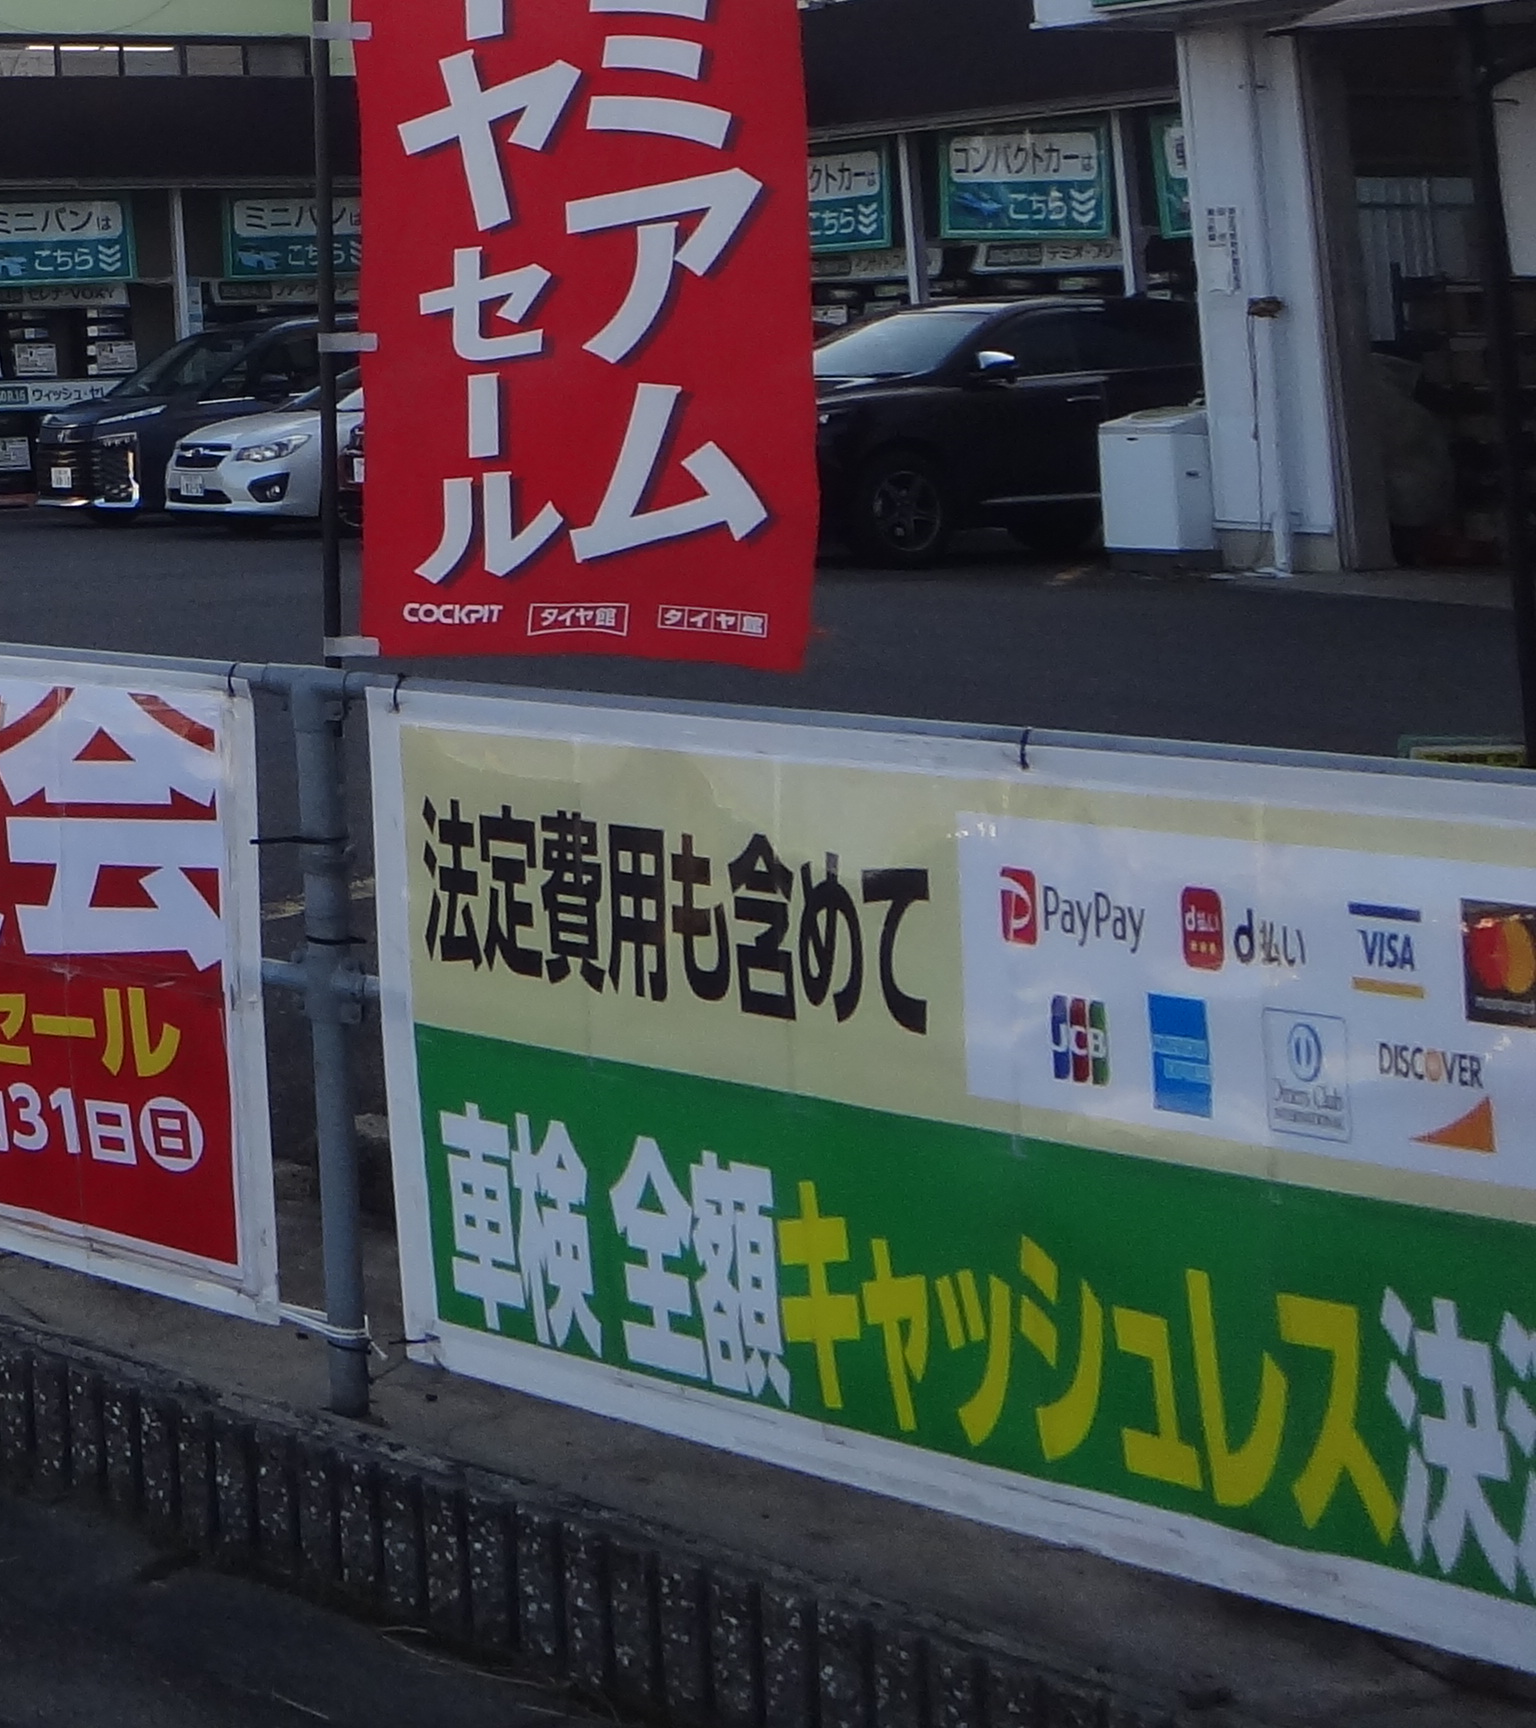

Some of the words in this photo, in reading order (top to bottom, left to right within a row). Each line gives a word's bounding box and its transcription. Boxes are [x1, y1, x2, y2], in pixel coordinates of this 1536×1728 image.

[954, 140, 1096, 174] コンパクトカーは
[1009, 192, 1067, 221] こちら
[34, 248, 95, 271] こちら
[403, 603, 503, 626] COCKPIT
[539, 605, 618, 629] タイヤ館
[663, 608, 765, 636] タイヤ館
[422, 795, 930, 1035] 法定費用も含めて
[1043, 884, 1146, 955] PayPay
[1357, 929, 1416, 971] VISA
[1050, 1027, 1108, 1059] JCB
[1378, 1040, 1484, 1090] DISCOVER
[439, 1102, 603, 1358] 車検
